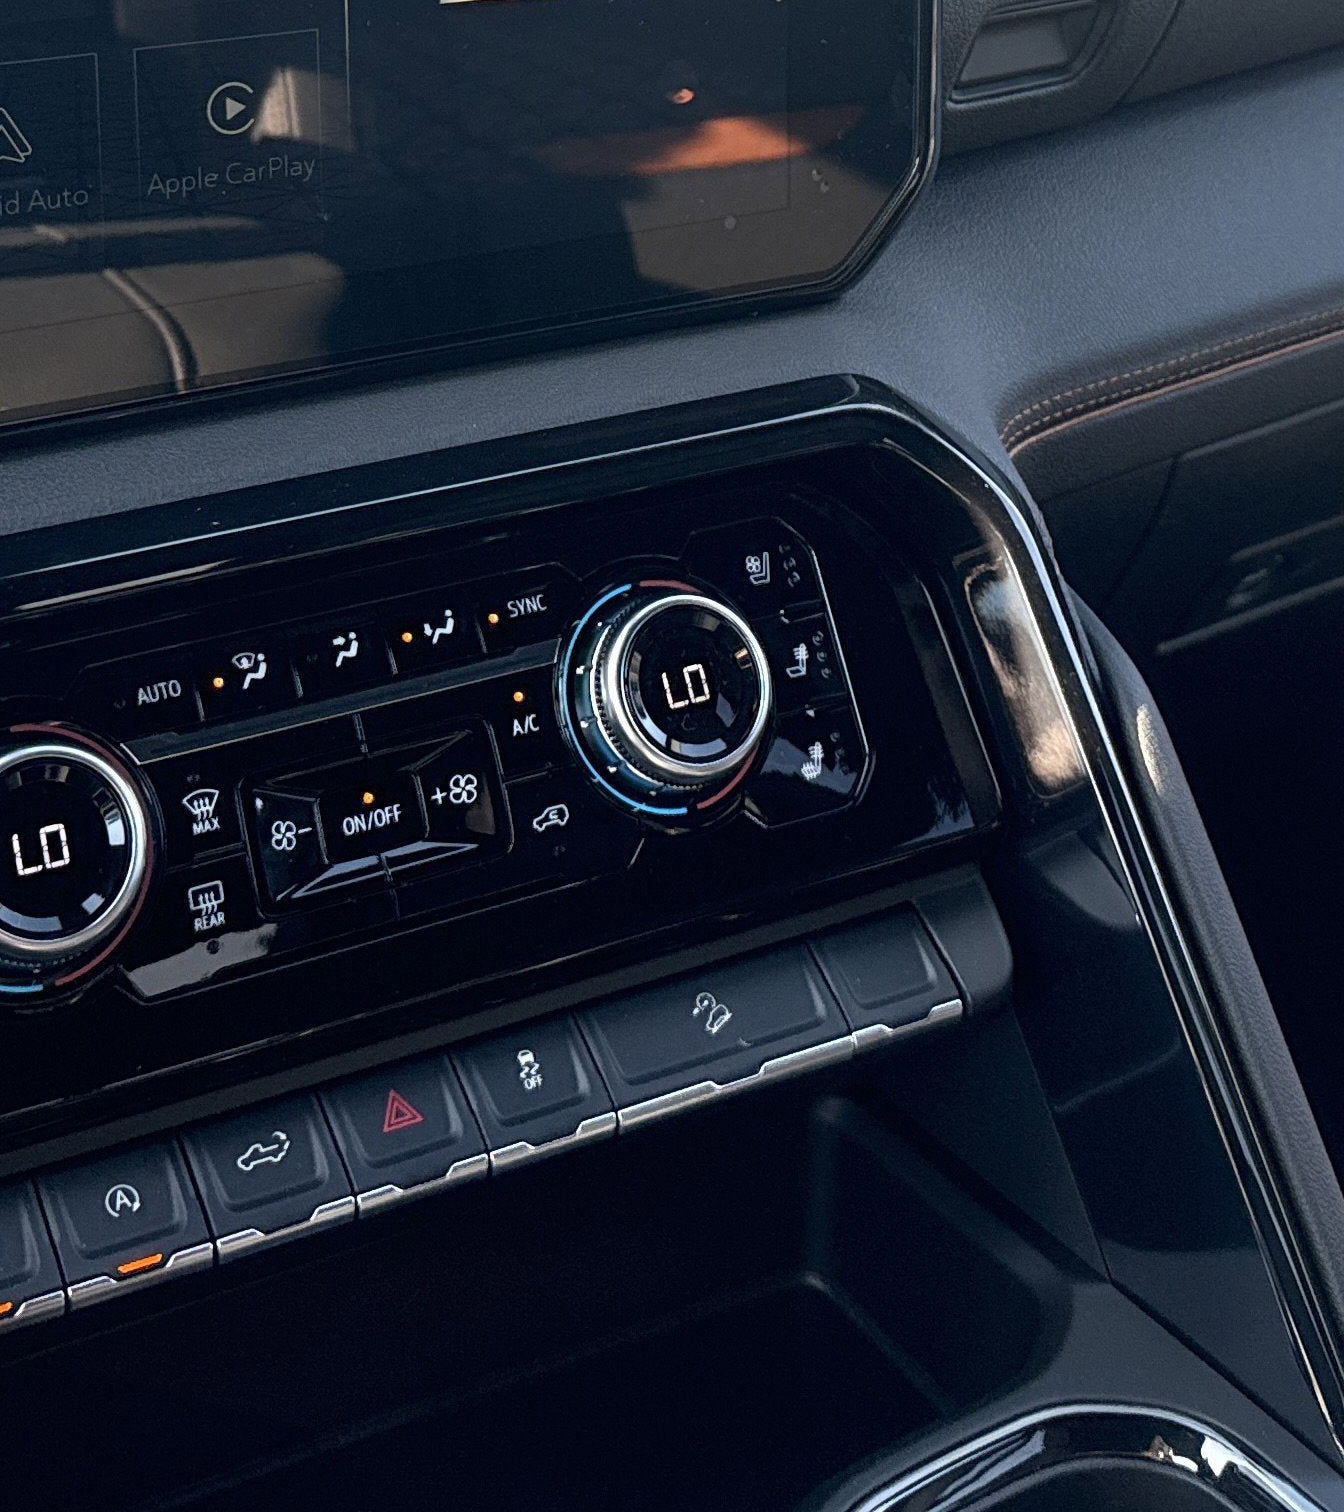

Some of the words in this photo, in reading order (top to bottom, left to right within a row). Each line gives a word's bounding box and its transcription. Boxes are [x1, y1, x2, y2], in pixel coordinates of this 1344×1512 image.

[147, 170, 220, 198] Apple
[225, 156, 316, 185] CarPlay
[28, 188, 90, 213] Auto
[507, 594, 548, 619] SYNC
[137, 679, 182, 707] AUTO
[512, 713, 540, 737] A/C
[193, 817, 221, 835] MAX
[342, 804, 403, 837] ON/OFF
[194, 911, 225, 932] REAR
[524, 1073, 543, 1090] OFF
